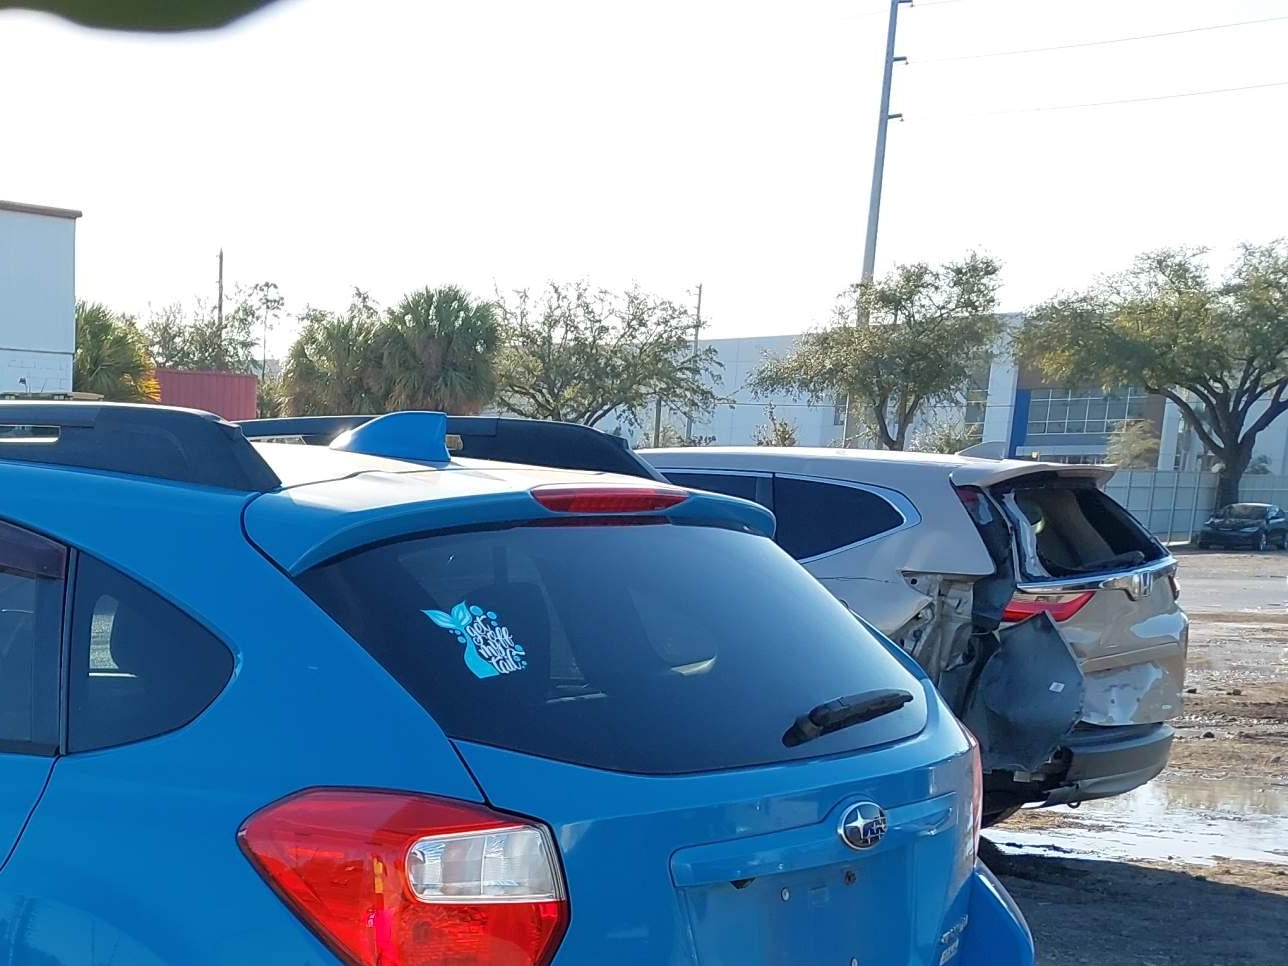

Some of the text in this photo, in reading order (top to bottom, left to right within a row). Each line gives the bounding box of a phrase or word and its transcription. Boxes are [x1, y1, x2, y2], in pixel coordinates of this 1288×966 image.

[466, 615, 490, 646] get
[487, 626, 514, 647] off
[479, 638, 507, 659] my
[489, 647, 525, 674] tail
